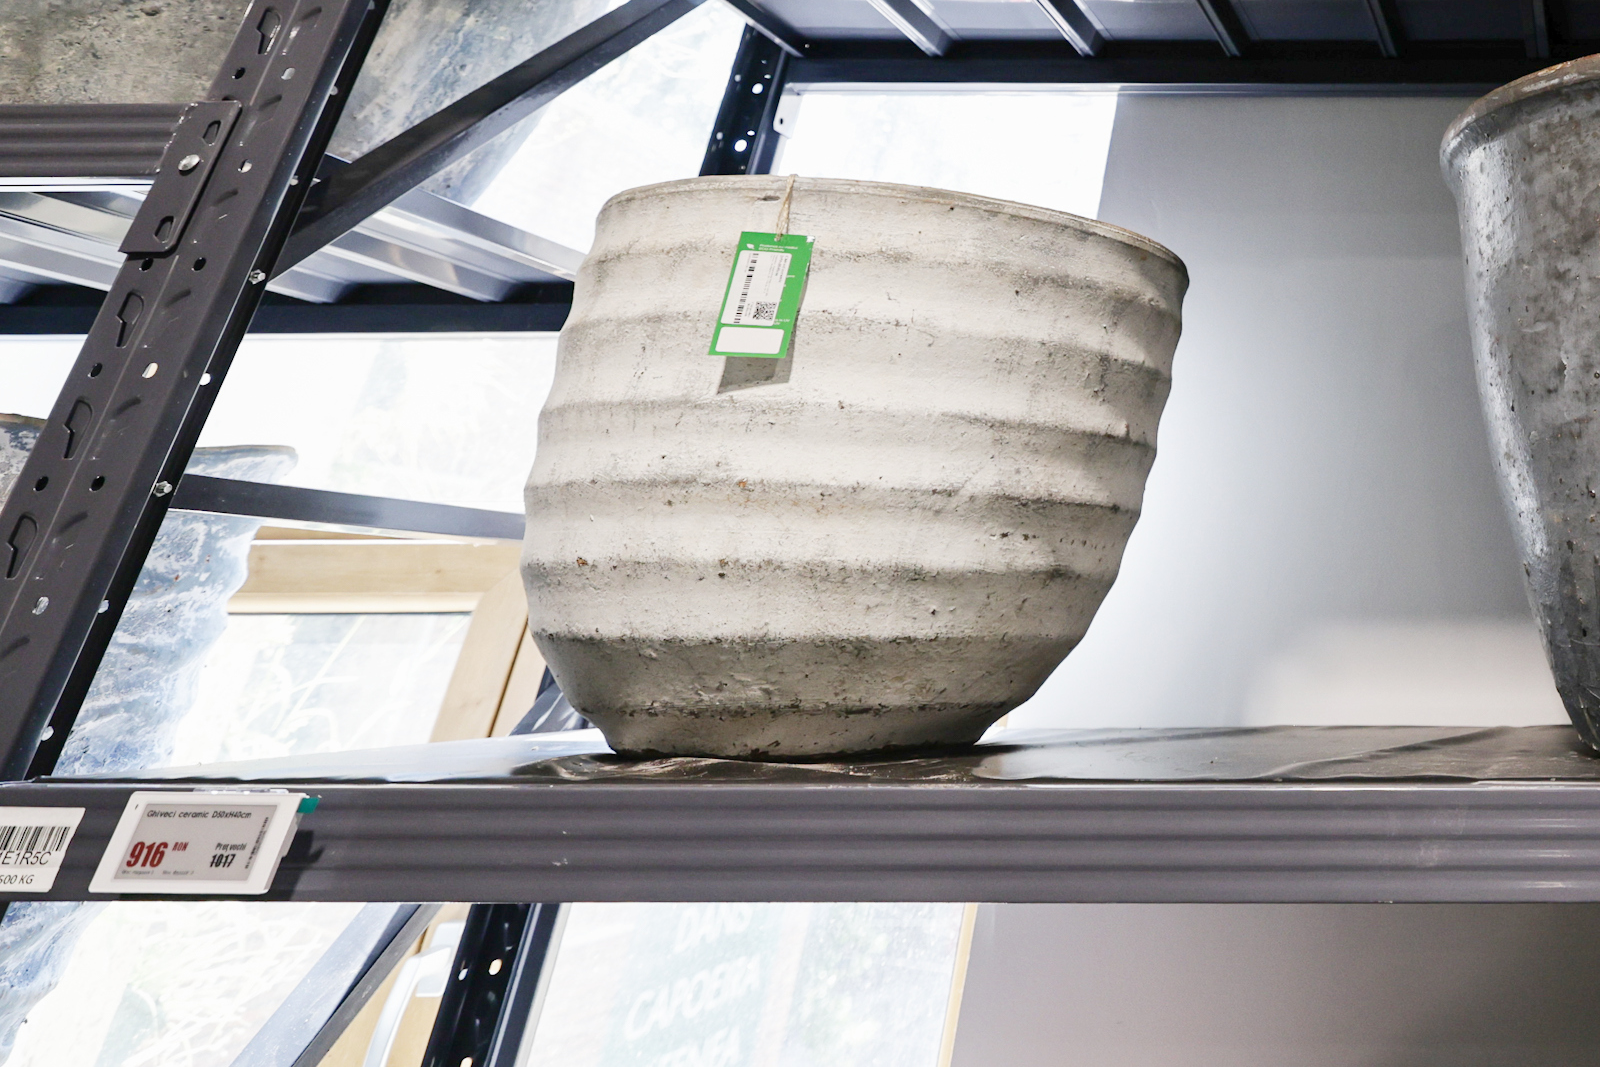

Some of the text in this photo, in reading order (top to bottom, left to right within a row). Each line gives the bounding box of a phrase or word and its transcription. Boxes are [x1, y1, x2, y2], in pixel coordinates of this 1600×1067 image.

[146, 809, 175, 819] Ghiveci
[178, 809, 209, 819] ceramic
[126, 841, 189, 869] 916 RON
[209, 853, 236, 868] 1017
[19, 874, 35, 885] KG
